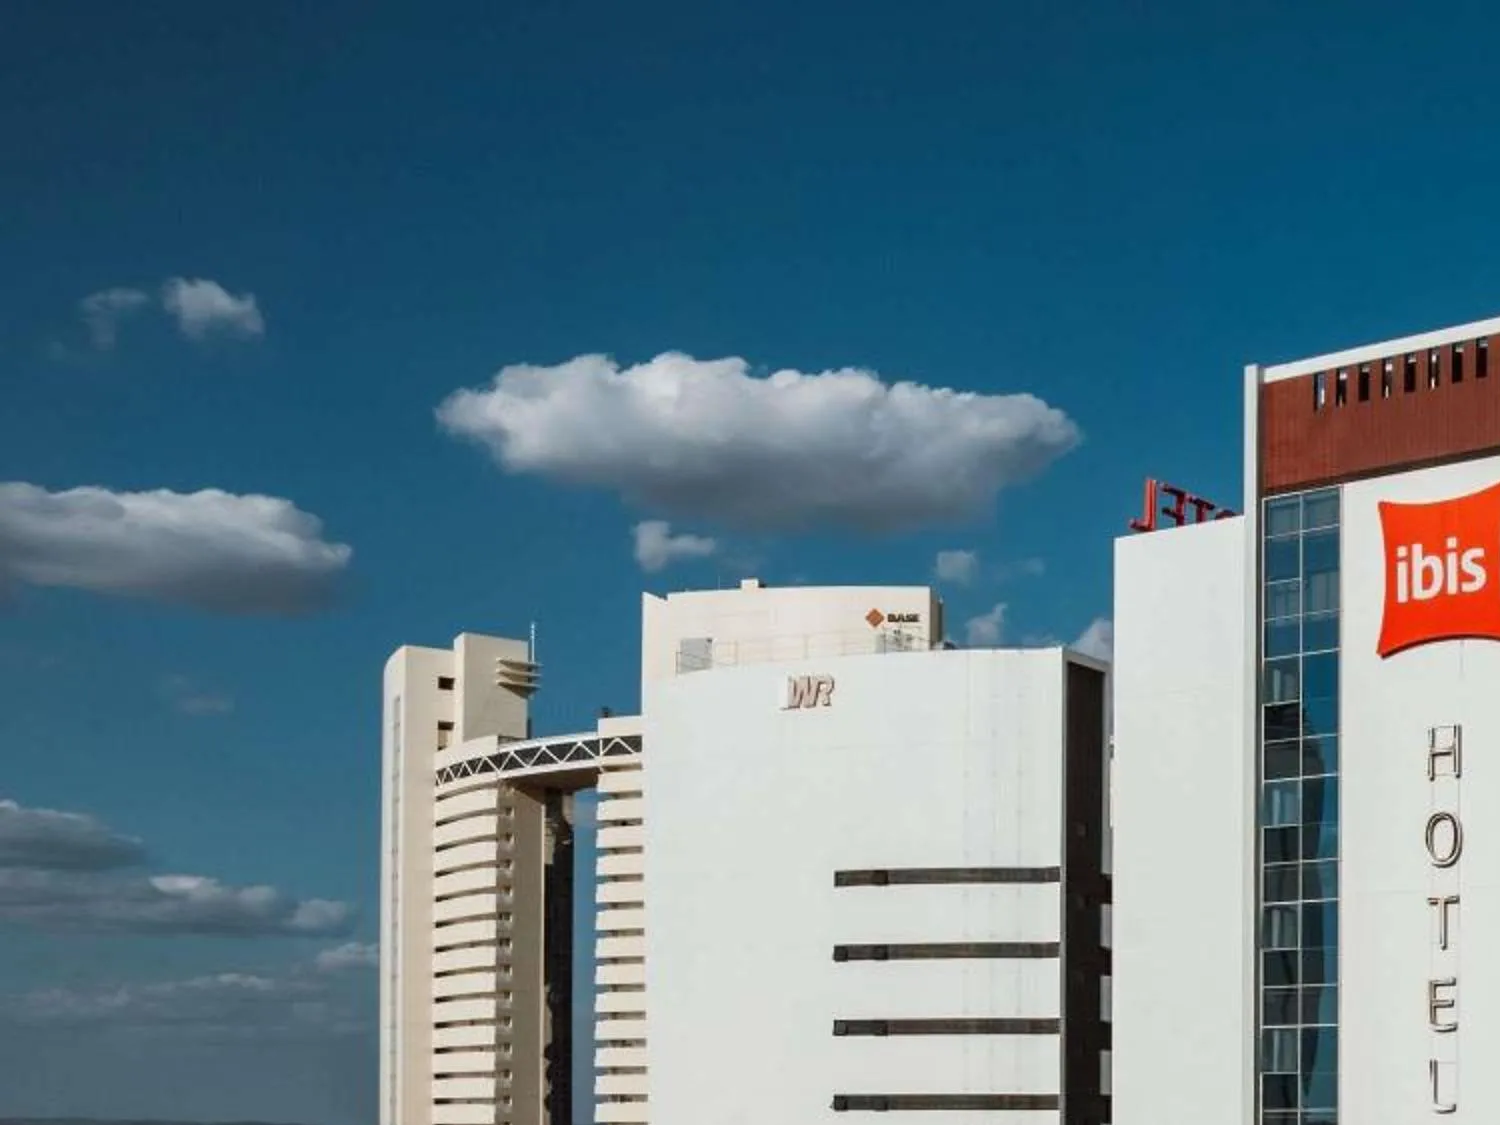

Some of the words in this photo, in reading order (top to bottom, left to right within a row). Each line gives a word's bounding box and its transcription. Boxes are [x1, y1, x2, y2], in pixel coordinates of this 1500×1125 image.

[1397, 536, 1487, 604] ibis
[782, 674, 835, 710] WR
[1425, 724, 1462, 1115] HOTEL
